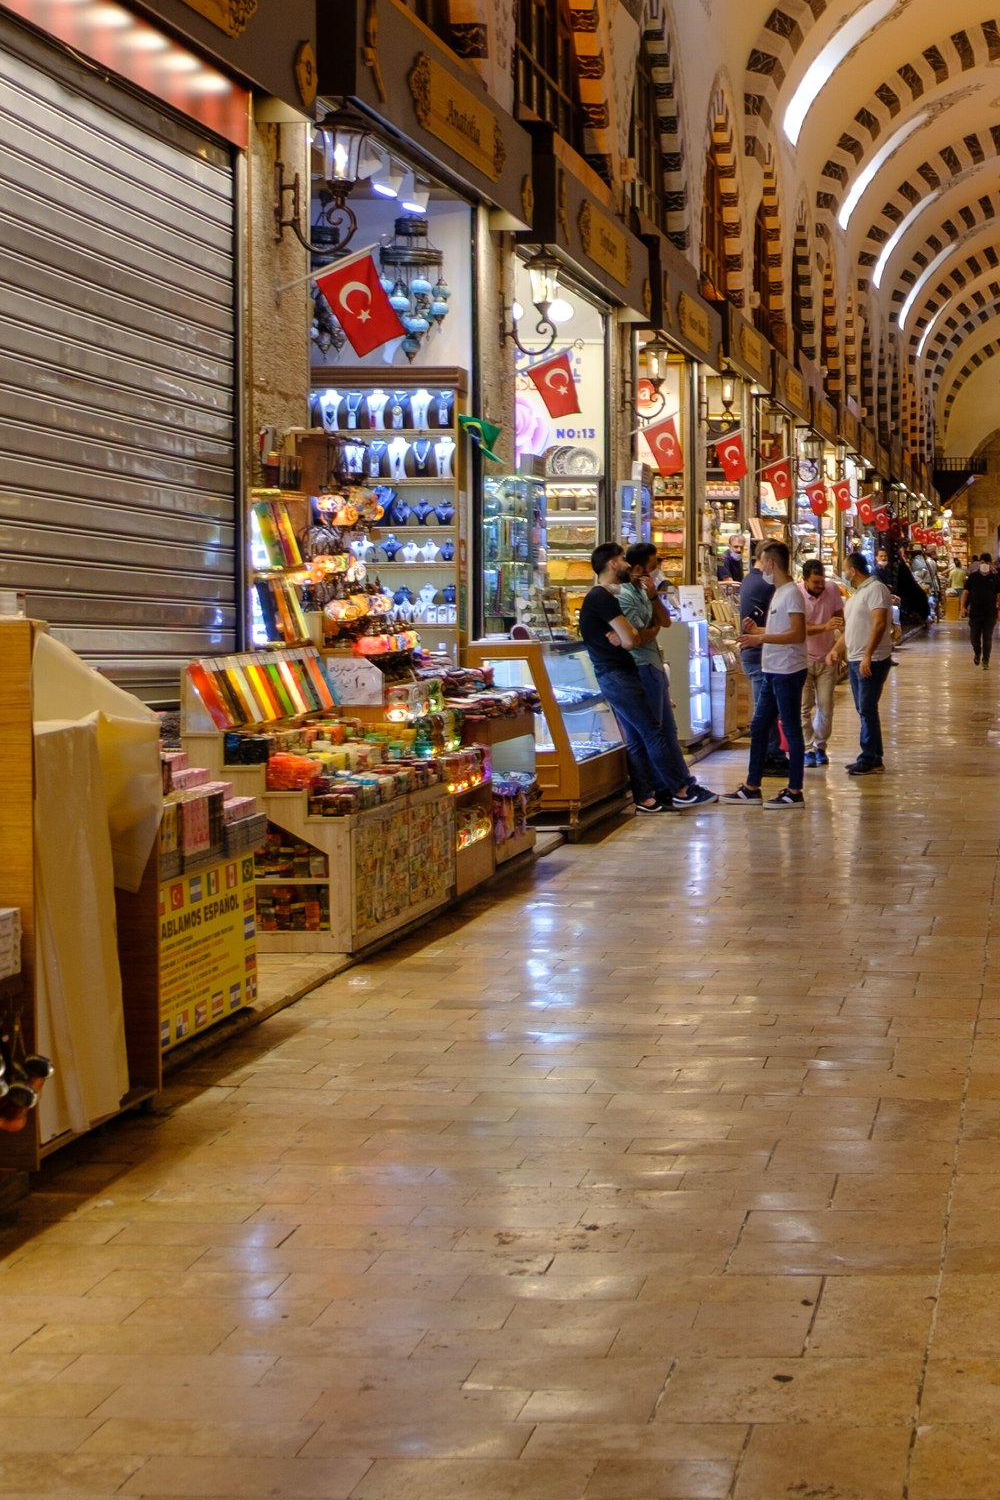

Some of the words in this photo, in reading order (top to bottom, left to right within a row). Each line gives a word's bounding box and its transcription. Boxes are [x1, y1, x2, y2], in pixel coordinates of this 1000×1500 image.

[306, 59, 312, 86] 9
[556, 428, 596, 439] NO:13
[161, 908, 202, 940] ABLAMOS
[204, 893, 240, 922] ESPAÑOL
